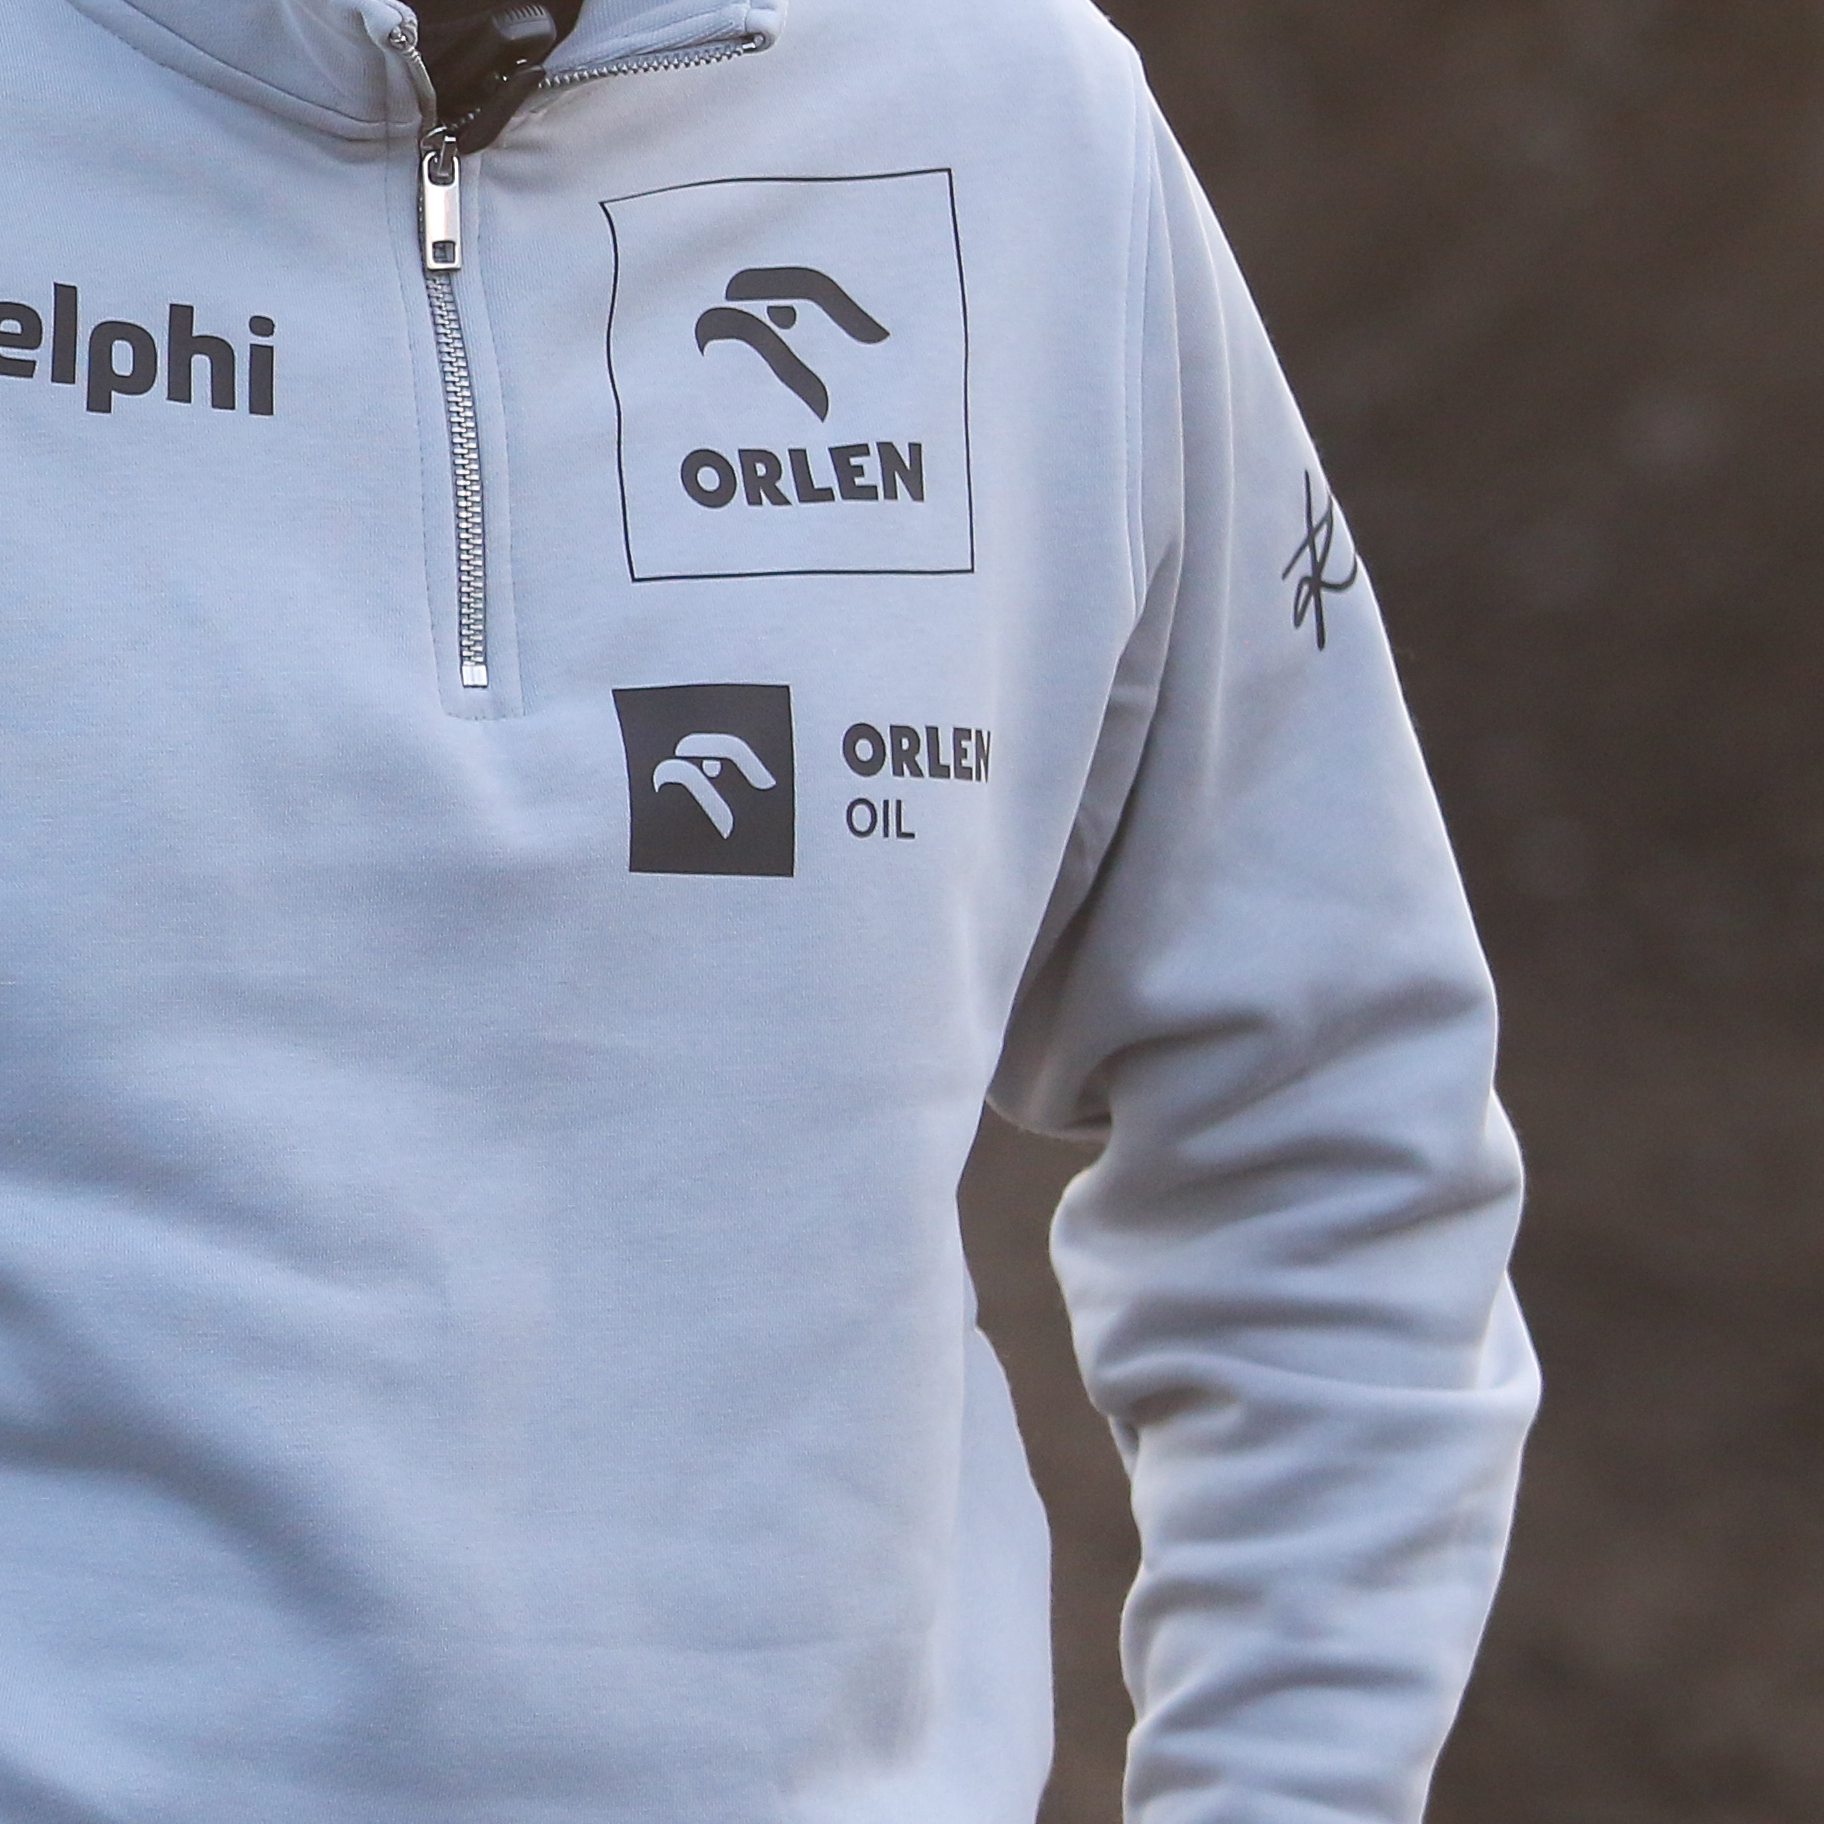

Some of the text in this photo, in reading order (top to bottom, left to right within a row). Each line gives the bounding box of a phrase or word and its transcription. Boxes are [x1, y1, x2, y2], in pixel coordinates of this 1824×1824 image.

[680, 442, 925, 509] ORLEN
[842, 723, 991, 783] ORLEN
[846, 798, 915, 839] OIL
